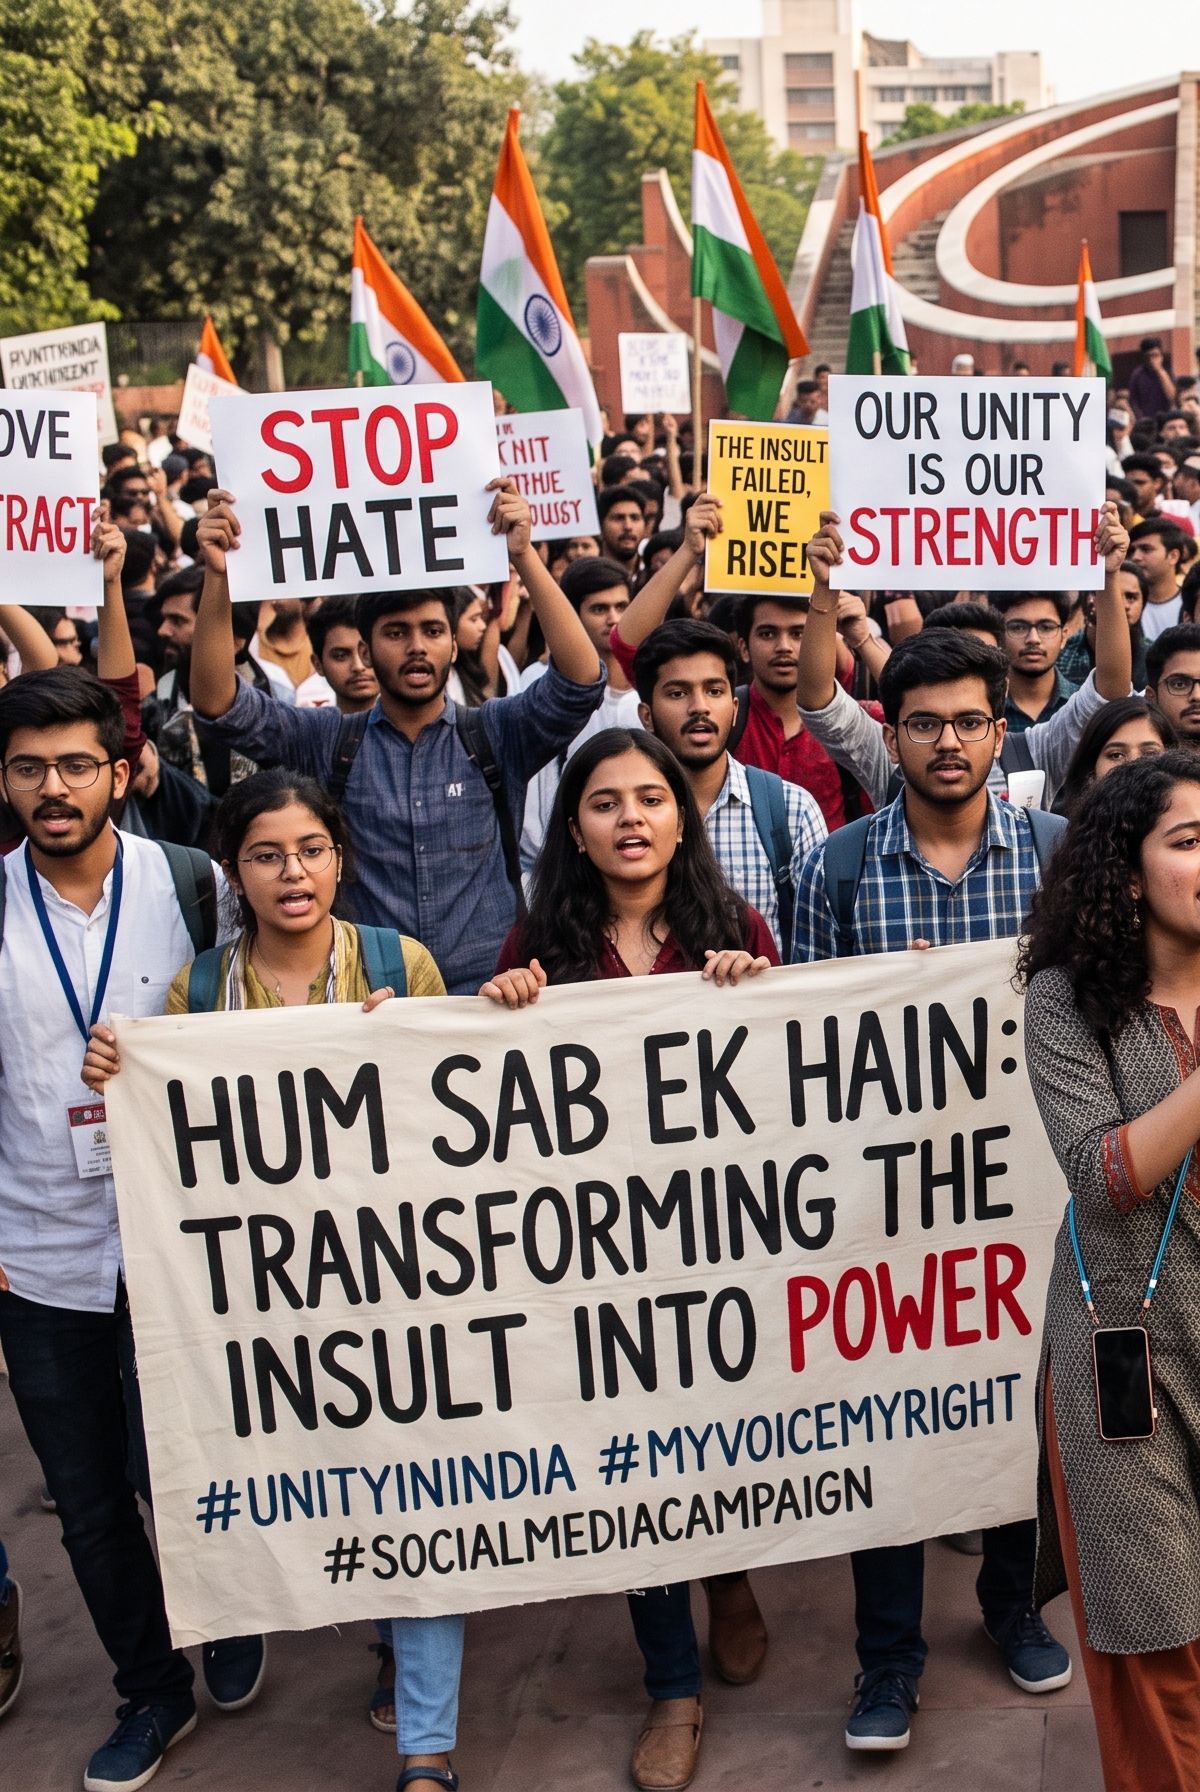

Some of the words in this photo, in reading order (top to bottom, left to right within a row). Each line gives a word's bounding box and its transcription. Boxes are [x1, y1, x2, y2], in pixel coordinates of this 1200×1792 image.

[262, 403, 458, 493] STOP
[717, 436, 754, 459] THE
[761, 438, 828, 463] INSULT
[855, 392, 940, 440] OUR
[961, 393, 1090, 441] UNITY
[732, 467, 810, 498] FAILED,
[909, 453, 945, 495] IS
[966, 453, 1045, 495] OUR
[265, 495, 464, 583] HATE
[747, 500, 790, 533] WE
[849, 508, 1098, 566] STRENGTH
[727, 539, 808, 579] RISE!
[167, 1063, 389, 1188] HUM
[432, 1044, 608, 1167] SAB
[644, 1026, 756, 1144] EK
[786, 997, 1017, 1127] HAIN:
[180, 1154, 836, 1315] TRANSFORMING
[863, 1125, 1013, 1237] THE
[226, 1313, 527, 1437] INSULT
[574, 1287, 756, 1401] INTO
[788, 1243, 1031, 1372] POWER
[196, 1444, 576, 1534] #UNITYININDIA
[599, 1375, 1022, 1484] #MYVOICEMYRIGHT
[325, 1466, 872, 1583] #SOCIALMEDIACAMPAIGN
